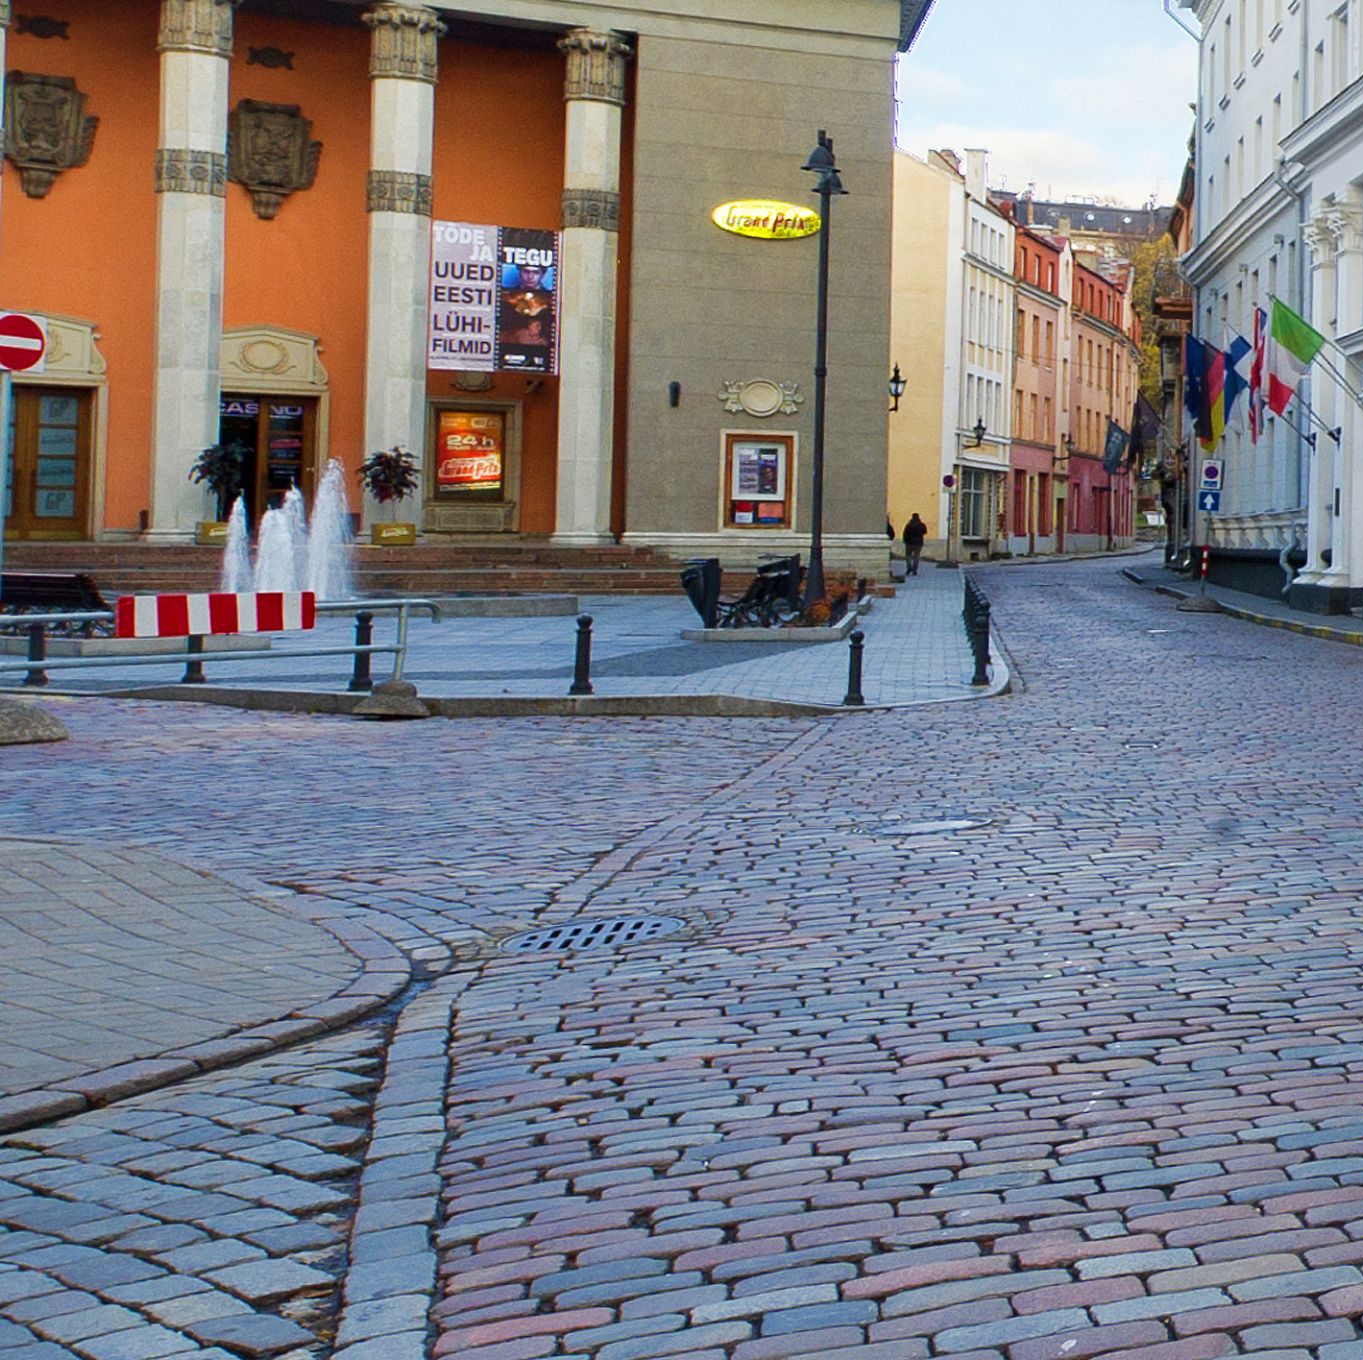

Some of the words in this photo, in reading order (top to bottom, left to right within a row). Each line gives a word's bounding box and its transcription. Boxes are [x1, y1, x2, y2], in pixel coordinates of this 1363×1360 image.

[470, 245, 494, 261] JA
[503, 247, 553, 266] TEGU
[435, 261, 494, 281] UUED
[433, 285, 492, 305] EESTI
[433, 311, 491, 333] LÜHI-
[432, 338, 492, 355] FILMID
